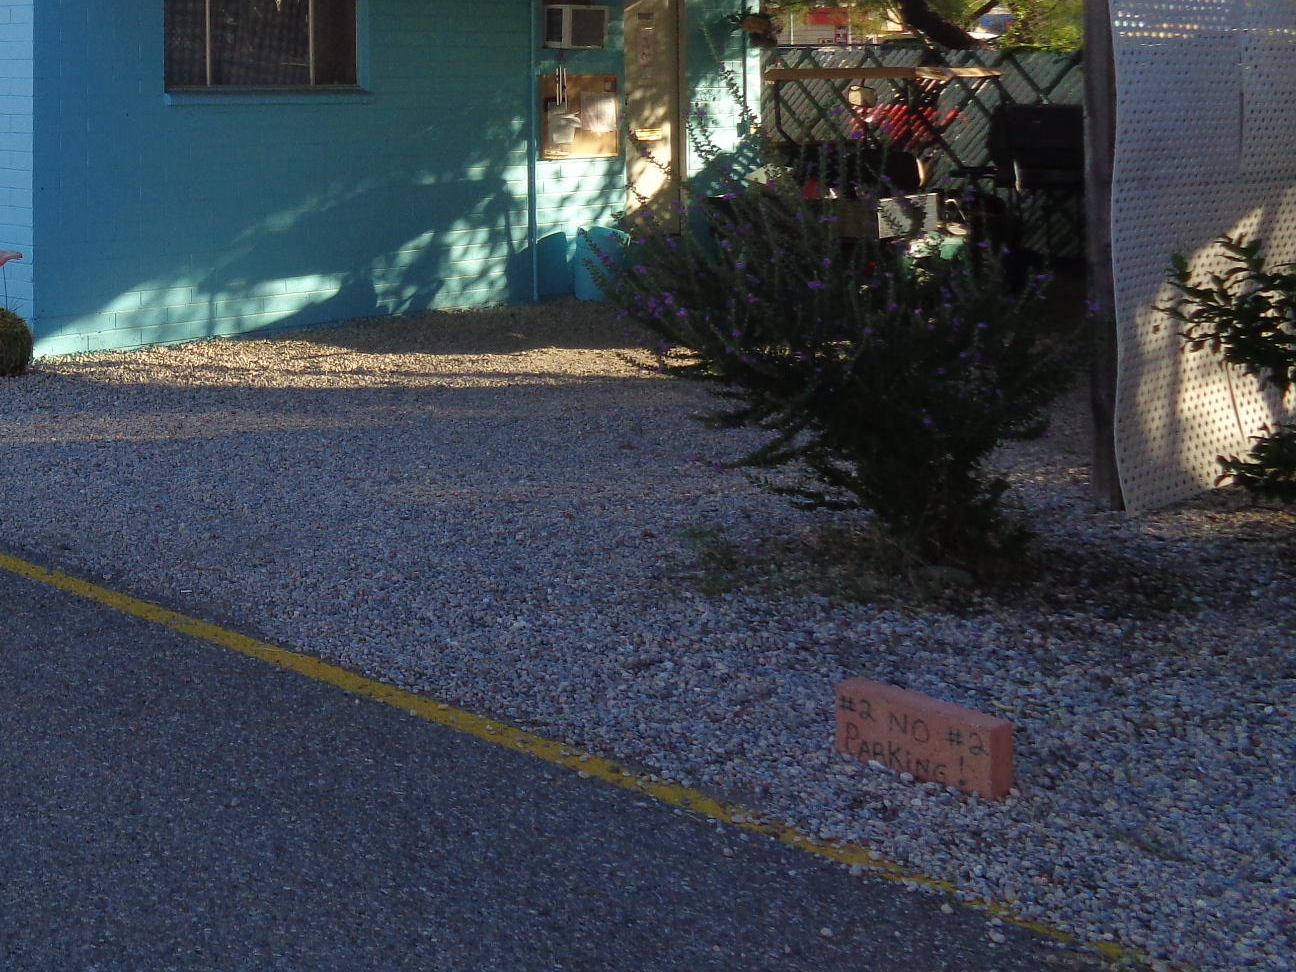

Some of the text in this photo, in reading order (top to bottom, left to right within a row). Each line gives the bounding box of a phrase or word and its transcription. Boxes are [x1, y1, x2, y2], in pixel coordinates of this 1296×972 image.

[839, 695, 990, 756] #2 NO #2
